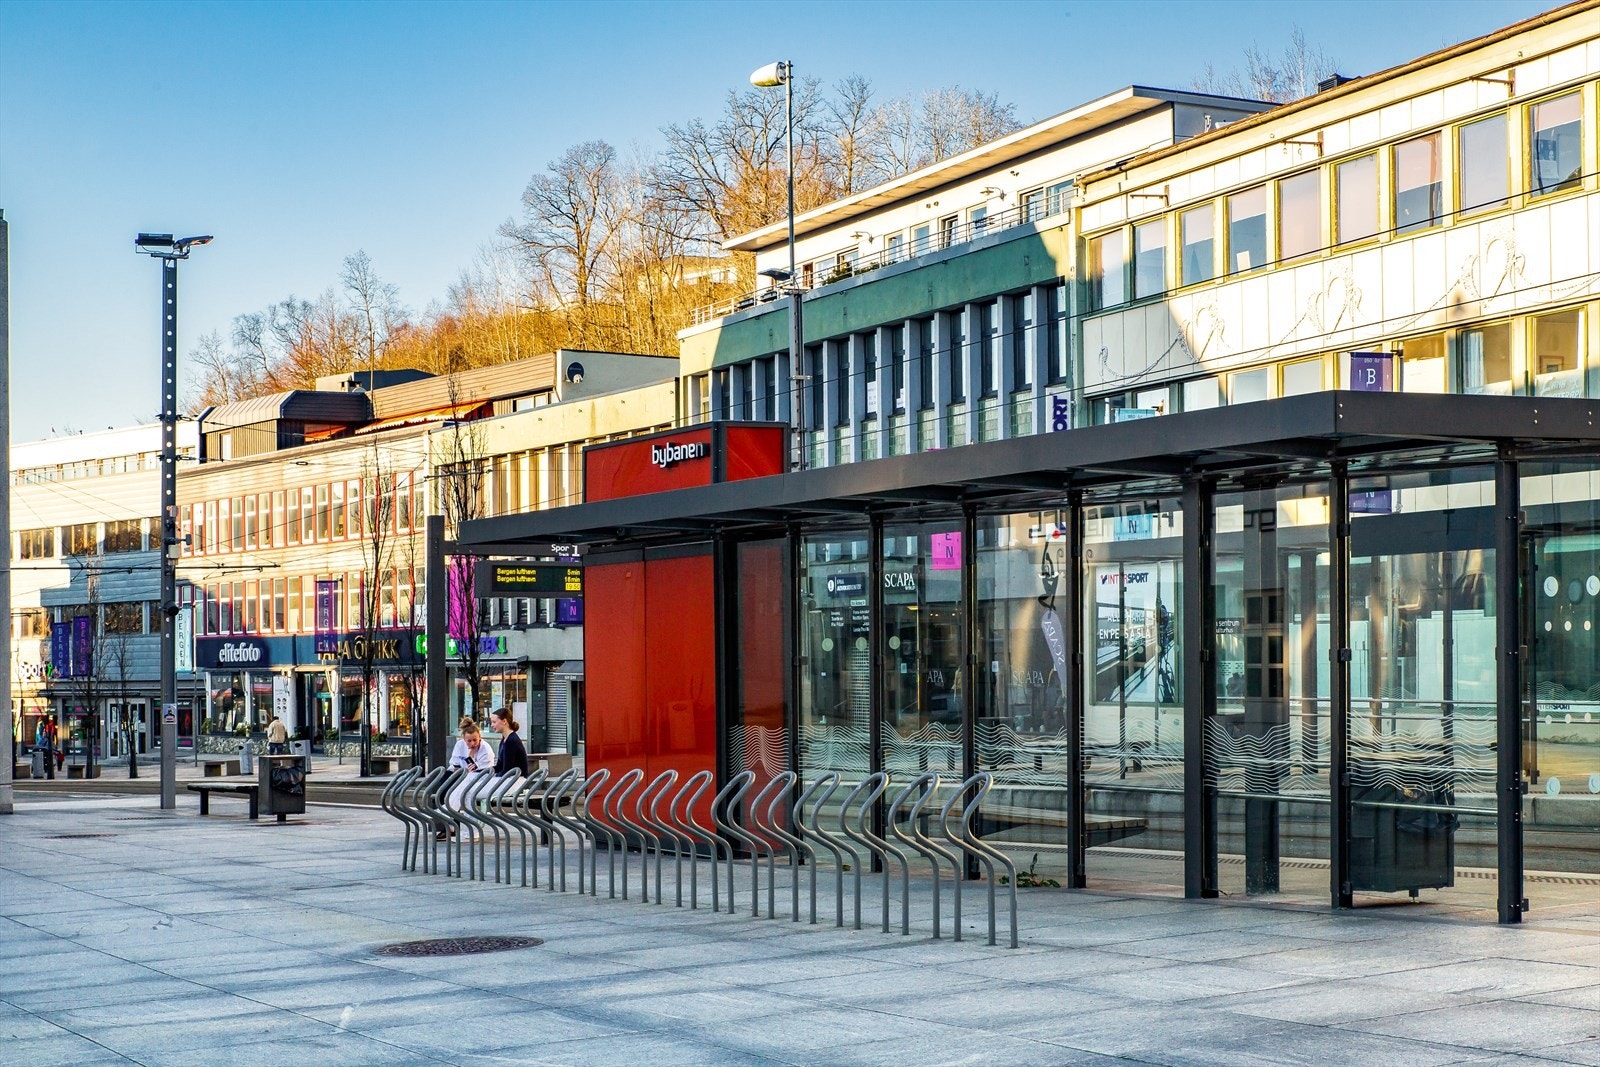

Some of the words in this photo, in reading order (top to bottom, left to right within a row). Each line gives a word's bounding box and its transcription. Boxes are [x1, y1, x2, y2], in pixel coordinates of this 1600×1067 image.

[651, 442, 704, 468] bybanen
[551, 544, 570, 553] Spor
[572, 545, 580, 557] 1
[497, 568, 515, 576] Bergen
[1108, 572, 1149, 585] INTRSPORT
[884, 572, 916, 588] SCAPA
[1110, 627, 1129, 640] PES
[219, 642, 262, 662] elitefoto
